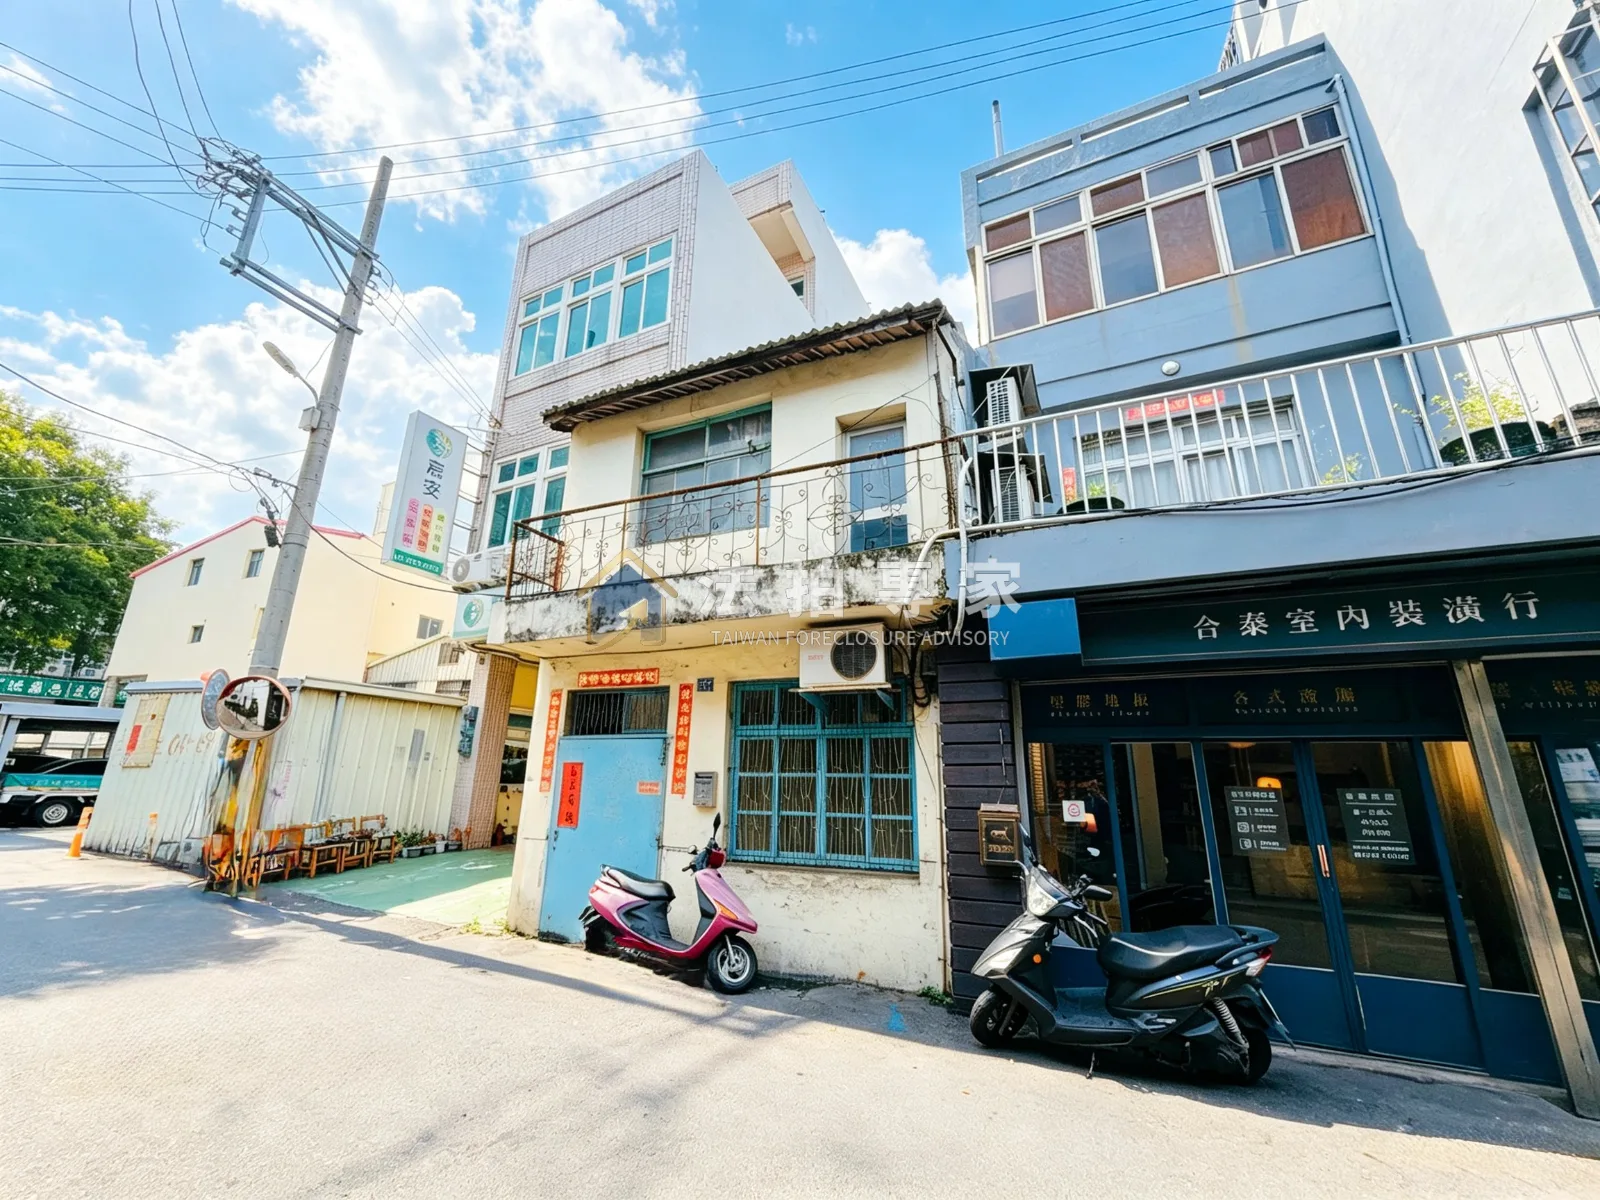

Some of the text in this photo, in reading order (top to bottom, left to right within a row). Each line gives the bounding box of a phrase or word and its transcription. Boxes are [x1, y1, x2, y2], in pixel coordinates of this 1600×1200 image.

[1193, 590, 1540, 641] 合泰室內裝潢行
